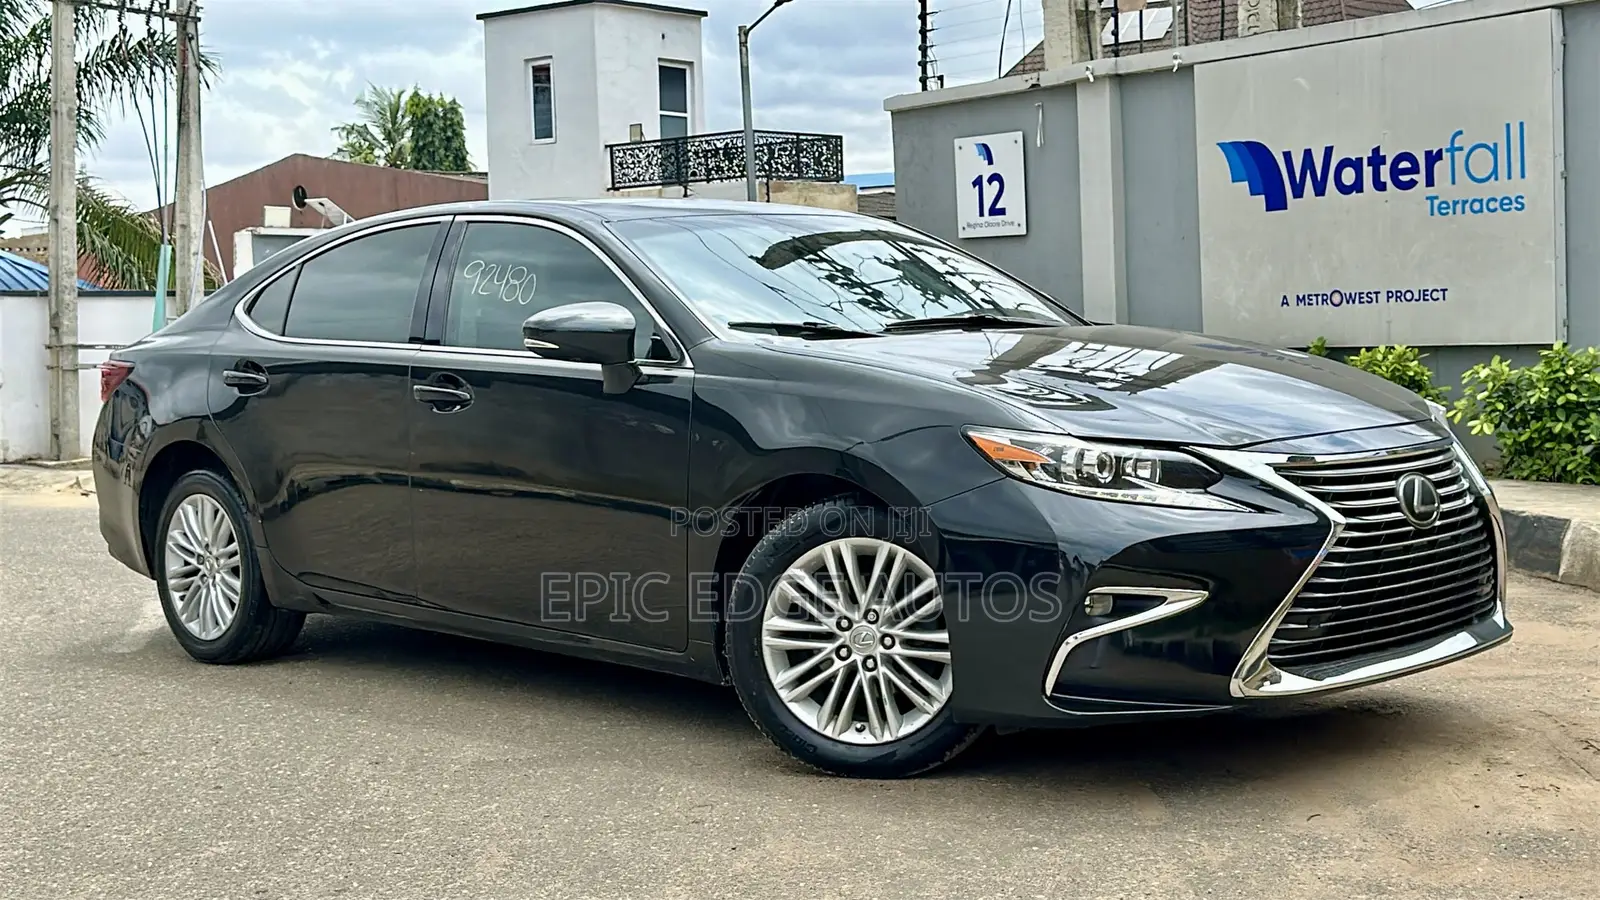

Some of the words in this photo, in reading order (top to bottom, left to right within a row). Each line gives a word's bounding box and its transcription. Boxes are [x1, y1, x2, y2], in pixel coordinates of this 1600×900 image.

[1282, 121, 1527, 200] Waterfall
[971, 172, 1007, 218] 12
[1425, 194, 1526, 217] Terraces
[1001, 219, 1015, 227] Drive
[463, 259, 537, 305] 92480
[1280, 294, 1290, 307] A
[1295, 289, 1381, 307] METROWEST
[1386, 288, 1449, 303] PROJECT
